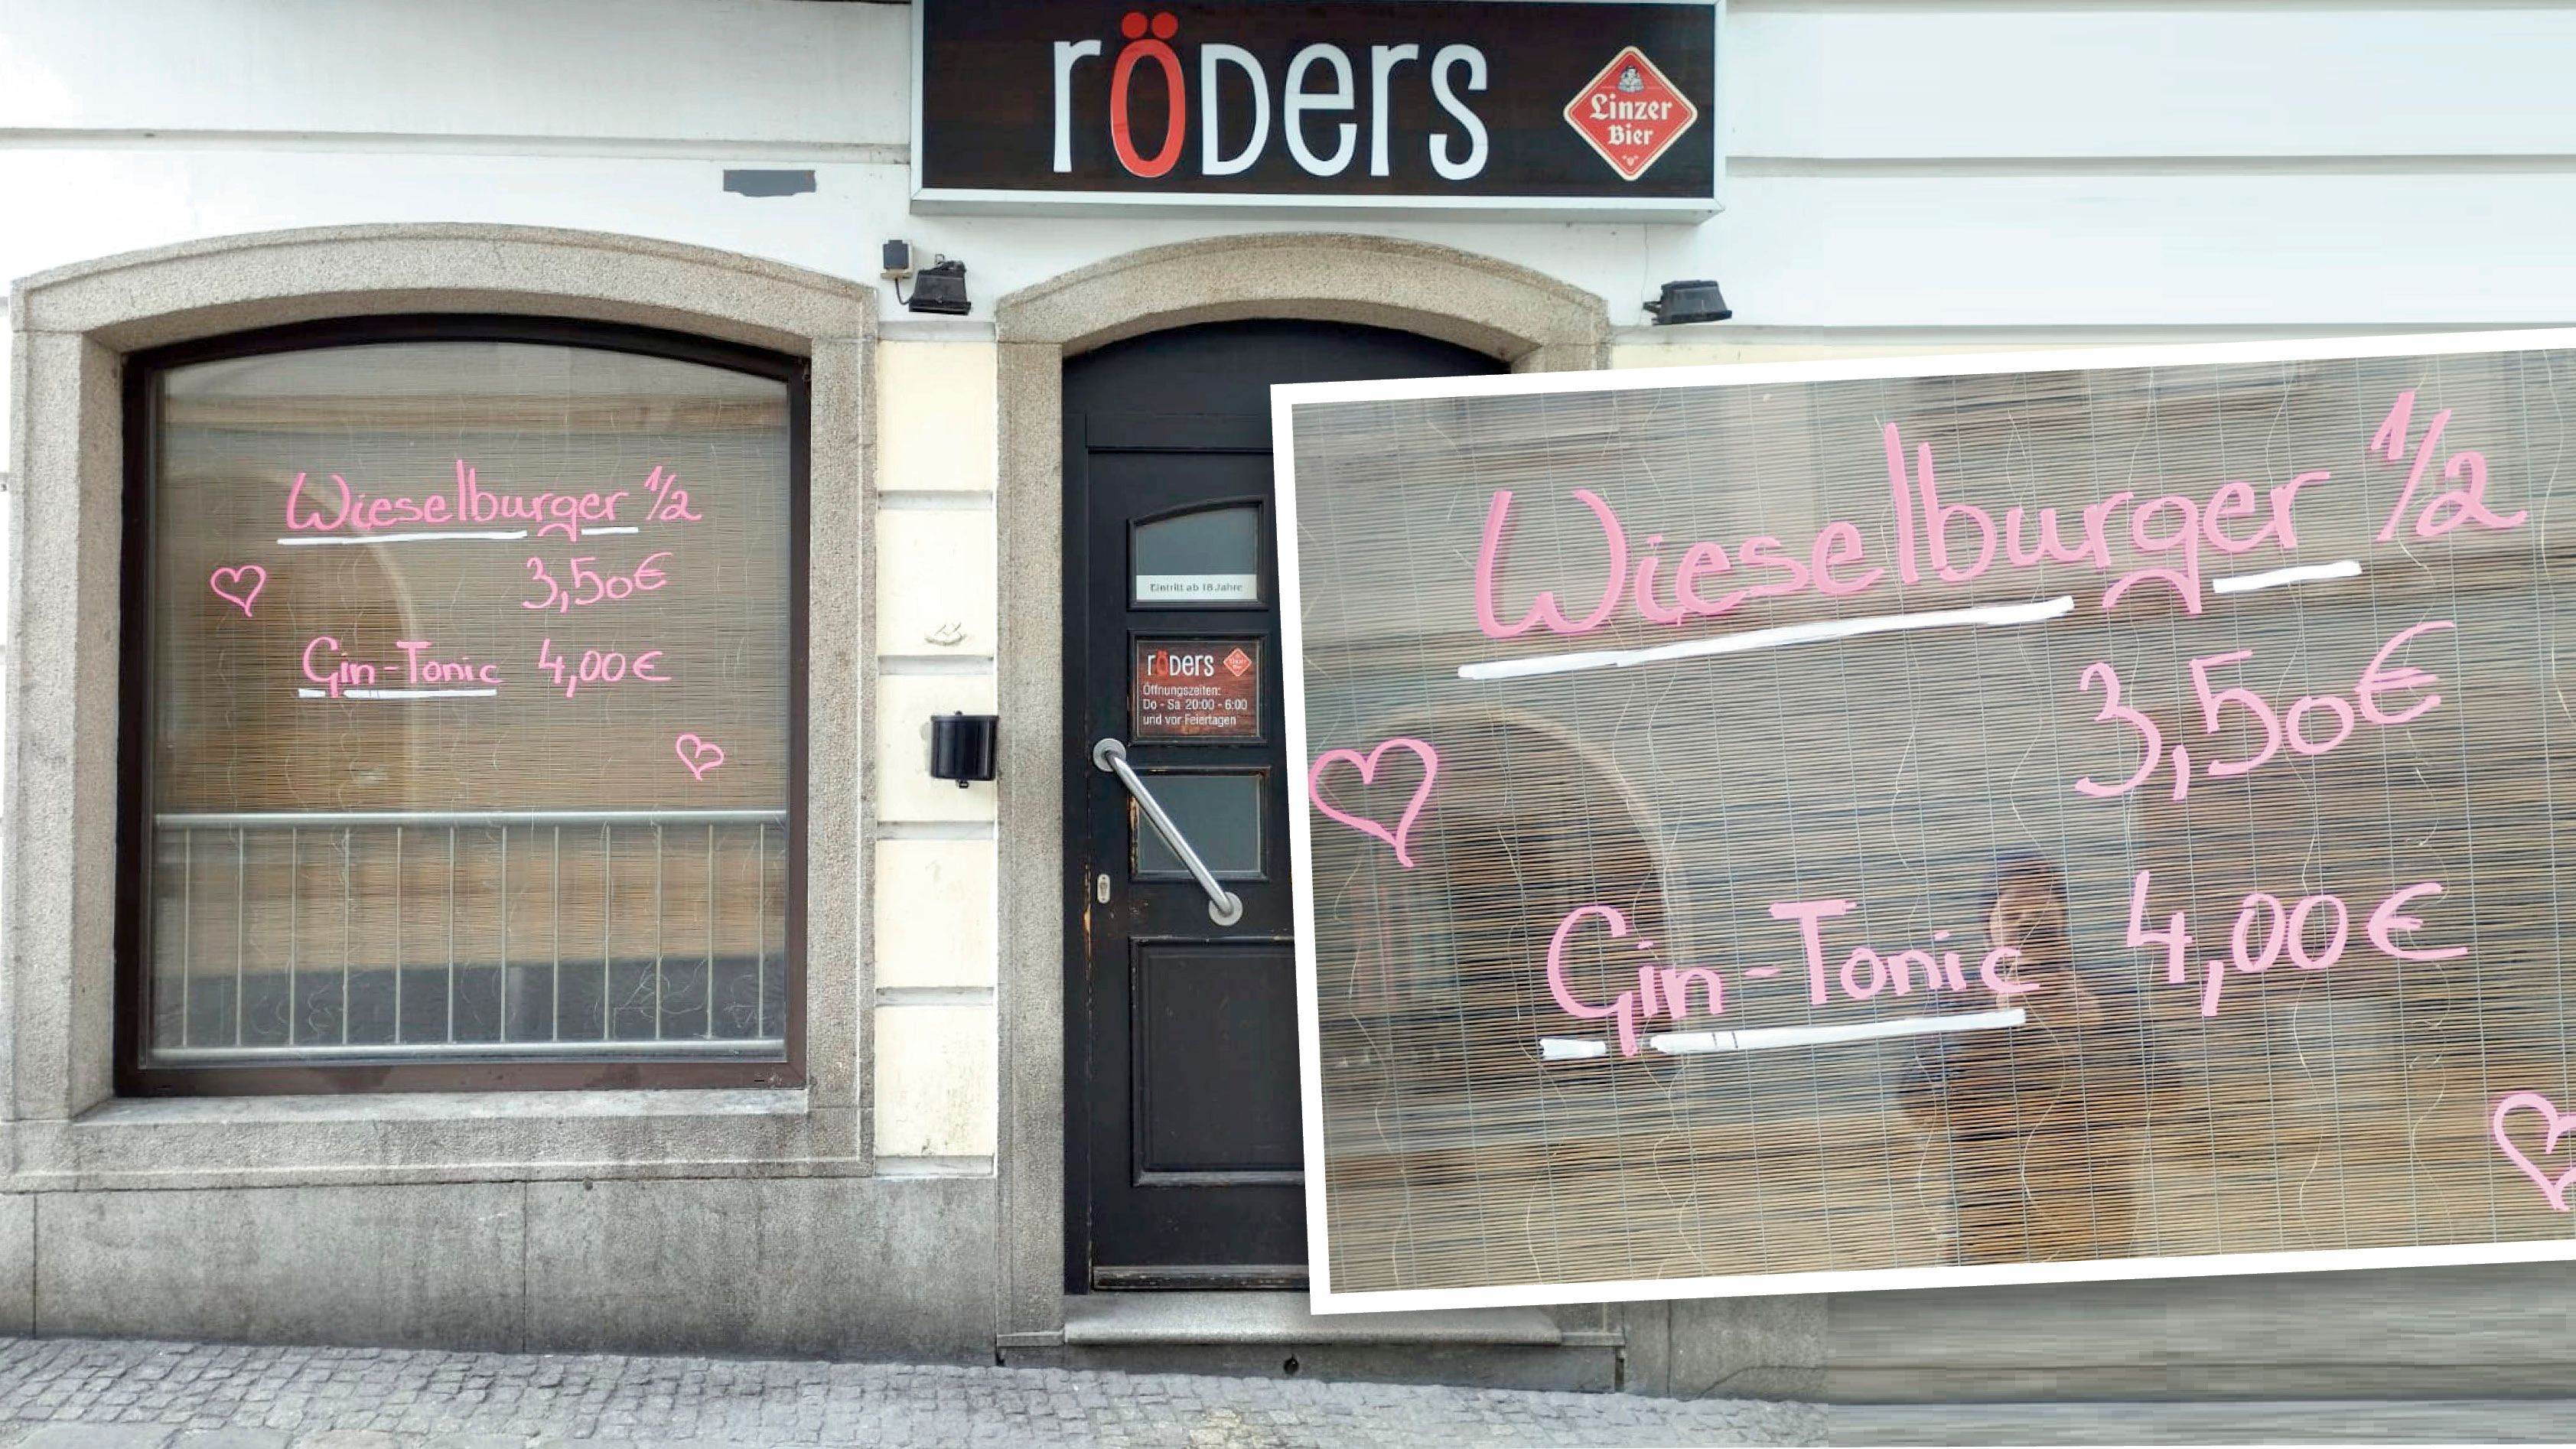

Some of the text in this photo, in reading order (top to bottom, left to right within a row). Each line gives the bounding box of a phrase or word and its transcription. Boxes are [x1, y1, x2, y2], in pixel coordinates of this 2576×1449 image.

[1589, 93, 1673, 120] Linzer
[1607, 122, 1654, 145] Bier
[285, 460, 630, 542] Wieselburger
[1475, 422, 2330, 615] Wieselburger
[522, 552, 673, 614] 3,50€
[1149, 582, 1243, 593] Eintritt ab 18 Jahre
[301, 636, 672, 698] Gin-Tonic 4,00€
[1142, 681, 1222, 698] Öffnungszeiten:
[1142, 698, 1157, 711] Do
[1167, 699, 1181, 711] Sa
[1185, 698, 1215, 711] 20:00
[1225, 698, 1248, 711] 6:00
[2074, 620, 2455, 802] 3,50€
[1142, 714, 1236, 728] und vor Feiertagen
[1547, 869, 2469, 1057] Gin-Tonic 4,00€
